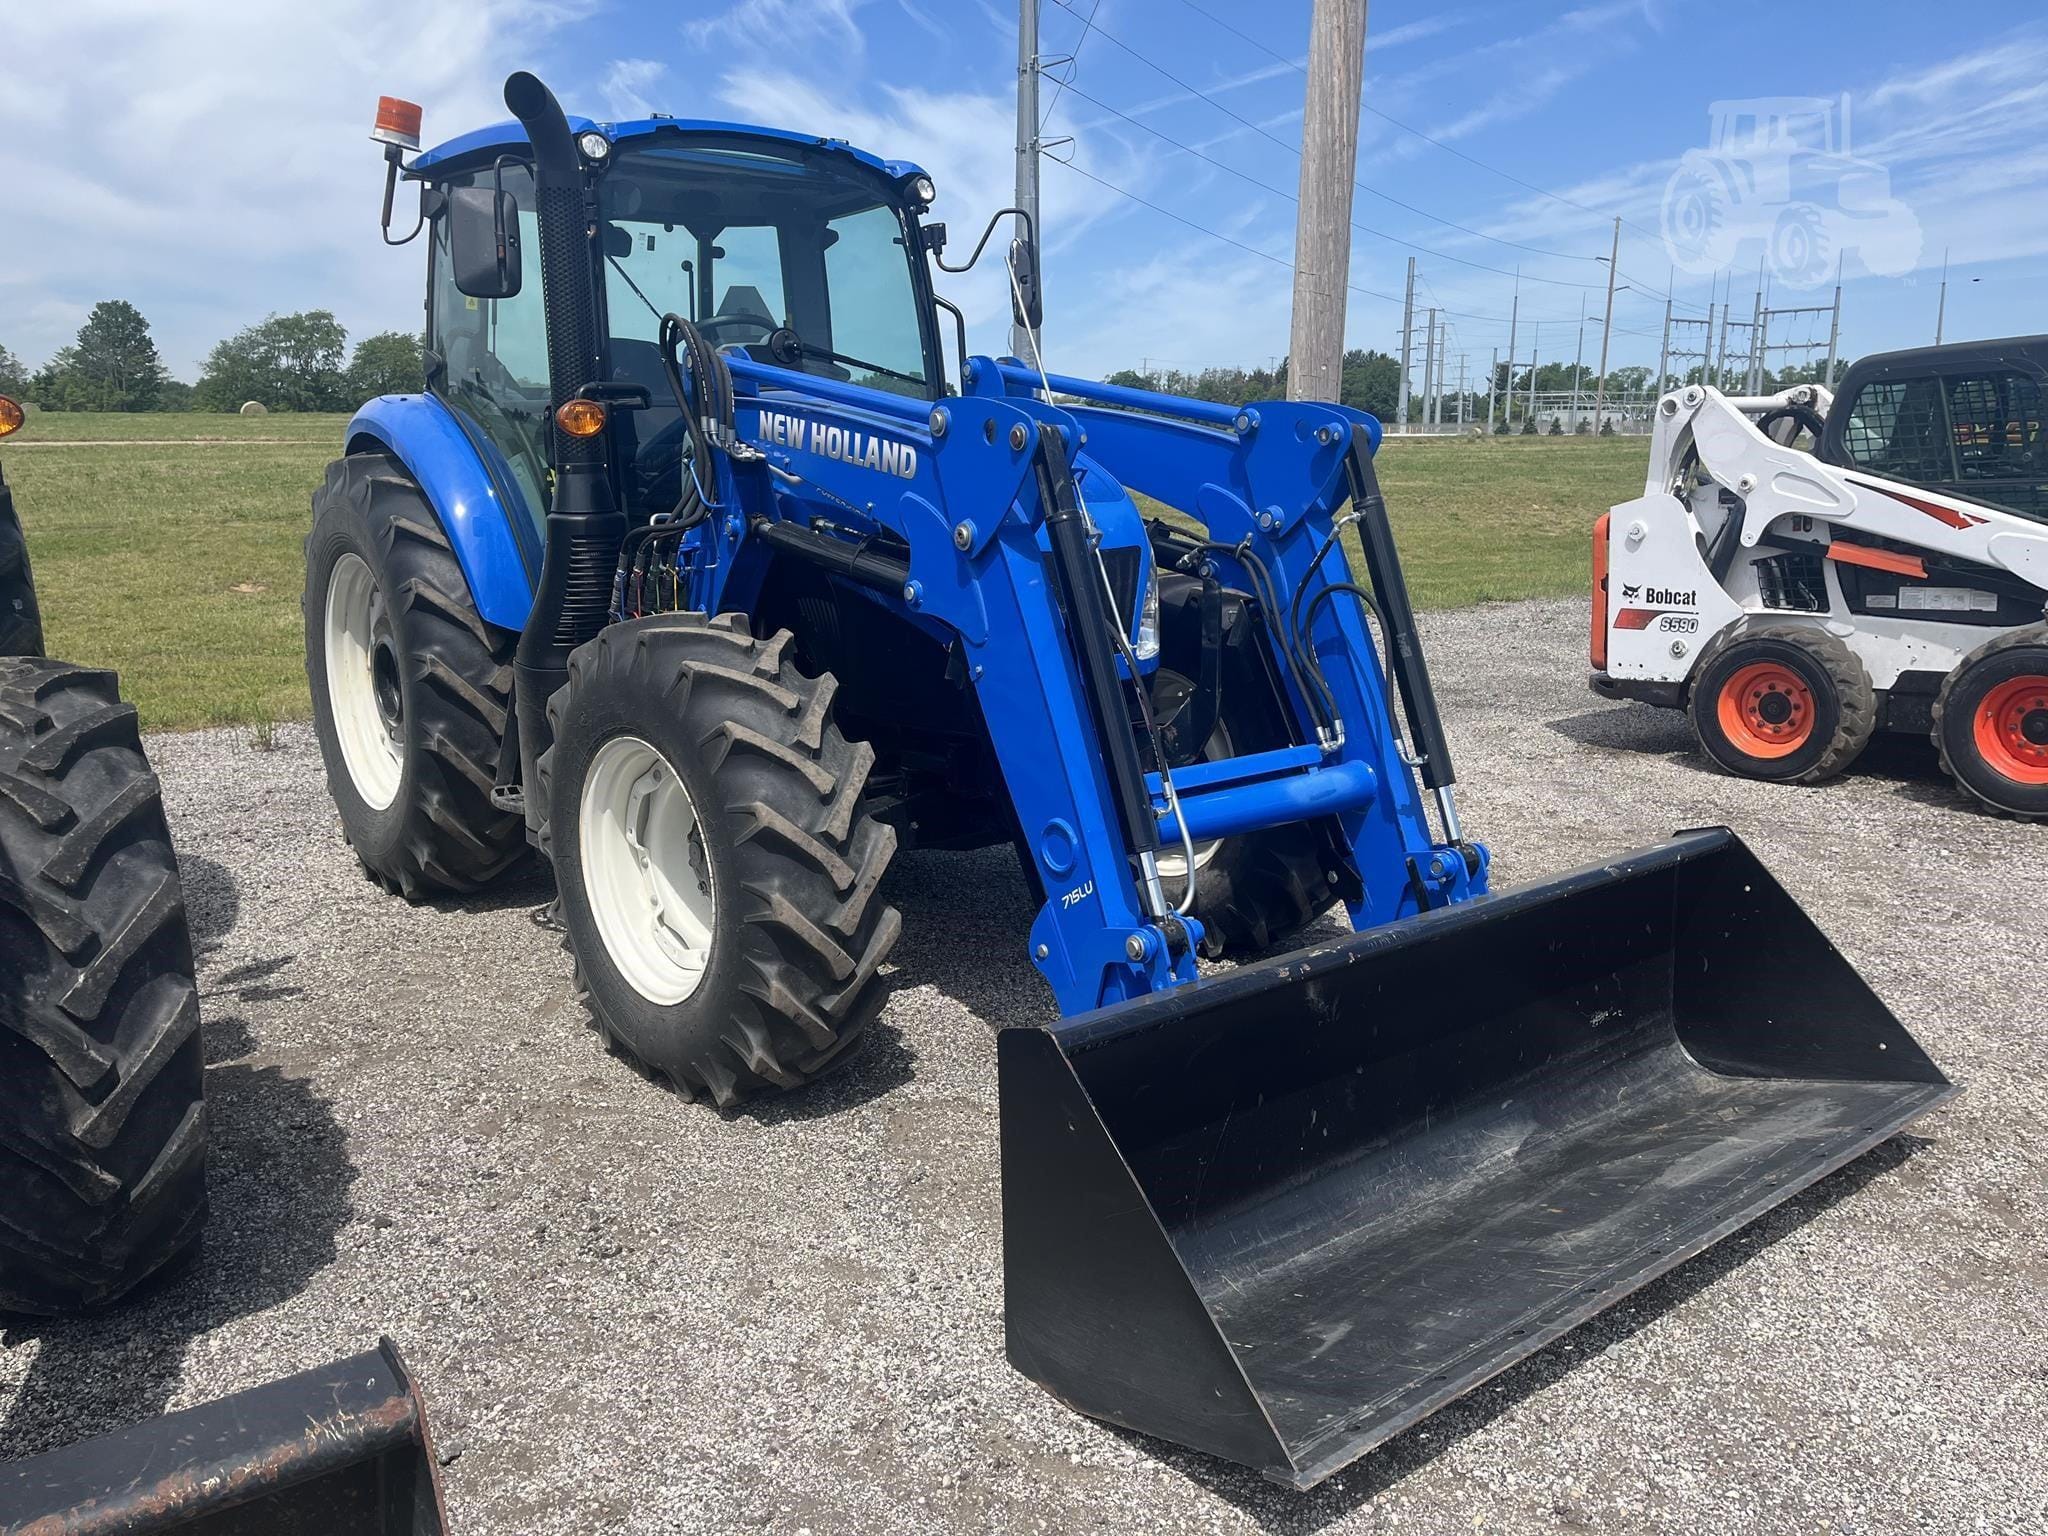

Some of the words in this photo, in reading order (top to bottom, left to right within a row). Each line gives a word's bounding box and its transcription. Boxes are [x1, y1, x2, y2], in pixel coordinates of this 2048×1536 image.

[759, 410, 806, 450] NEW
[811, 422, 917, 480] HOLLAND
[1646, 588, 1697, 606] Bobcat
[1660, 617, 1699, 633] S590
[1061, 880, 1094, 910] 715LU
